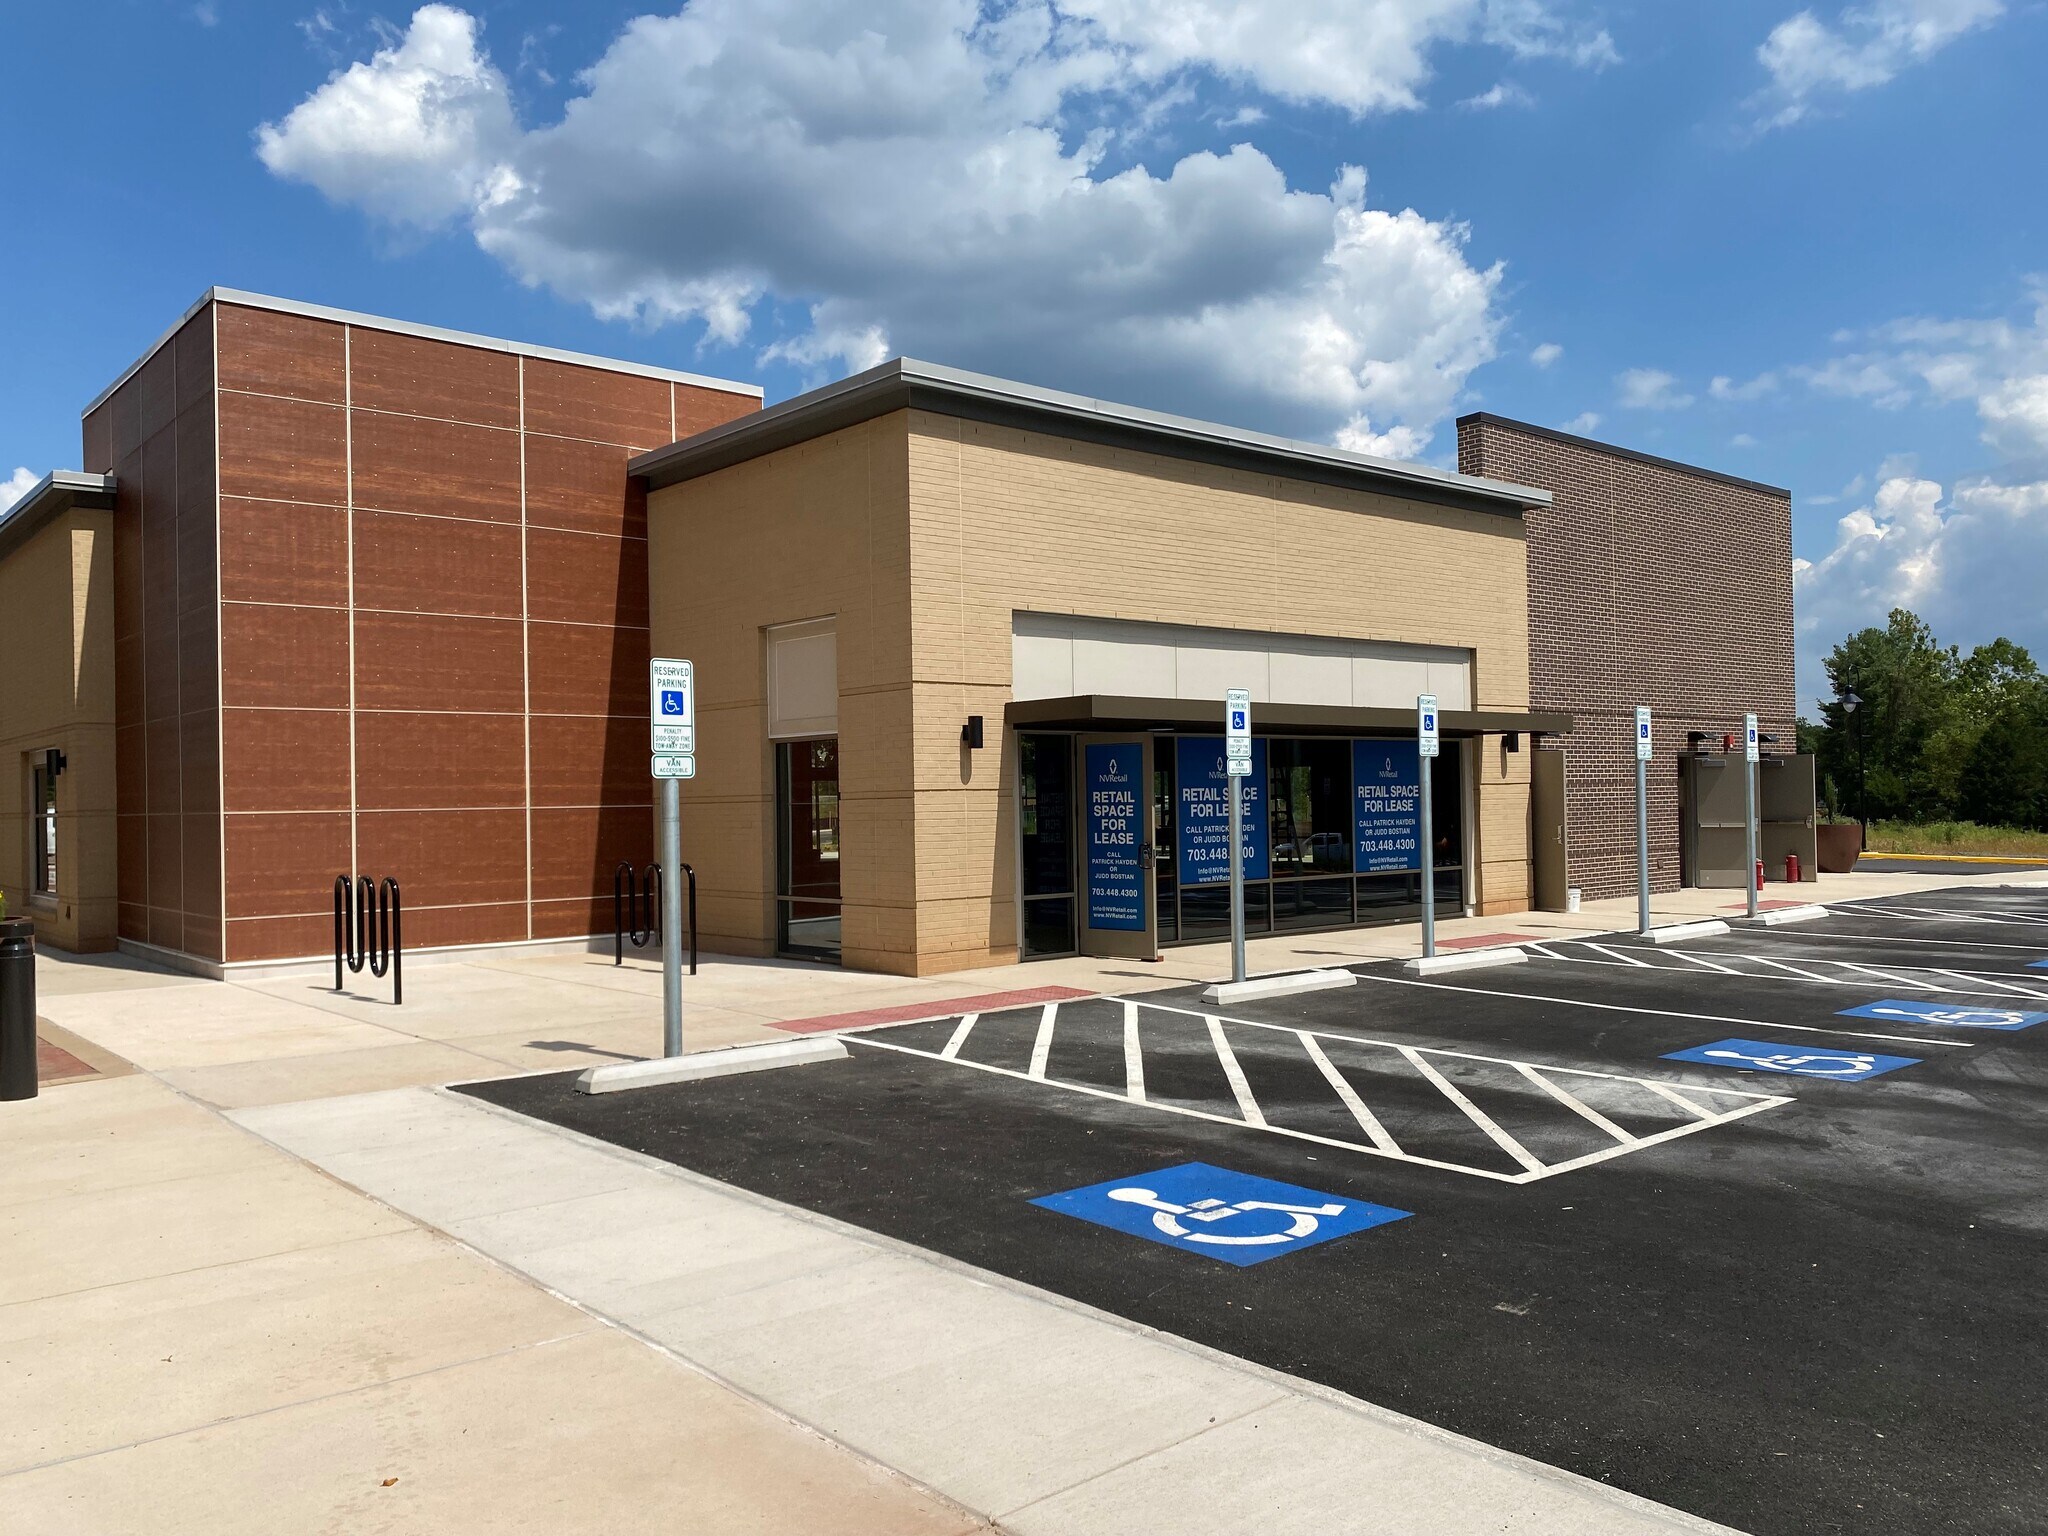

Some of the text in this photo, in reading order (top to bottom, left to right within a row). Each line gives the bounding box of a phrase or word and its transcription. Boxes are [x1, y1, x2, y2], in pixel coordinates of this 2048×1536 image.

[654, 666, 690, 677] RESERVED
[657, 678, 687, 689] PARKING
[666, 759, 681, 767] VAN
[1099, 774, 1128, 782] NVRetail
[1093, 791, 1135, 803] RETAIL
[1182, 787, 1258, 801] RETAIL SCE
[1358, 785, 1419, 798] RETAIL SPACE
[1093, 805, 1134, 817] SPACE
[1190, 803, 1251, 817] FOR LEE
[1364, 800, 1414, 813] FOR LEASE
[1101, 819, 1126, 830] FOR
[1373, 819, 1395, 827] PATRICK
[1396, 818, 1415, 826] HAYDEN
[1185, 826, 1202, 834] CALL
[1204, 825, 1230, 833] PATRICK
[1374, 828, 1387, 836] JUDD
[1094, 832, 1134, 845] LEASE
[1193, 836, 1203, 844] OR
[1204, 835, 1221, 843] JUDD
[1360, 839, 1415, 852] 703.448.4300
[1187, 846, 1255, 861] 703.448.00
[1092, 888, 1138, 897] 703.448.4300
